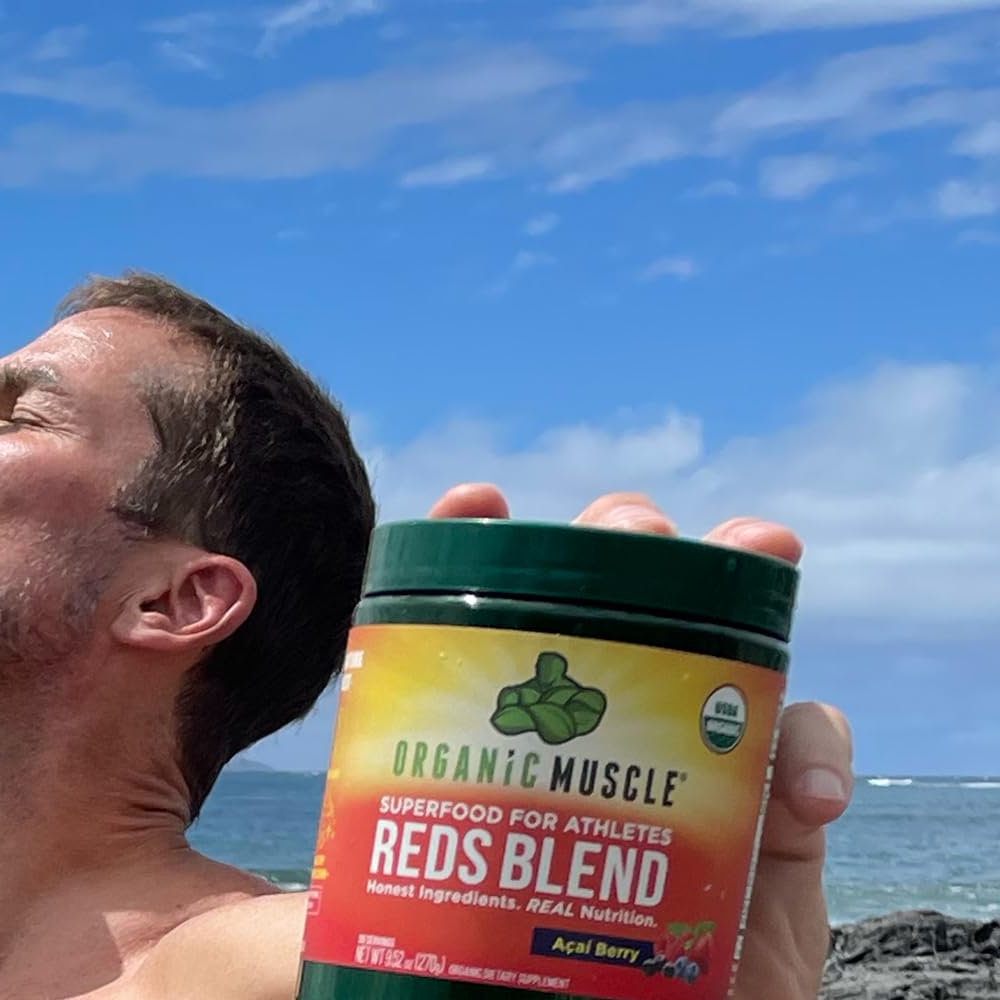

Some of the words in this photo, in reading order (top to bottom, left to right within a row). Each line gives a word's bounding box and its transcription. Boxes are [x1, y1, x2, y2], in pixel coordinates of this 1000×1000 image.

[379, 796, 503, 825] SUPERFOOD
[509, 809, 558, 830] FOR
[563, 816, 674, 846] ATHLETES
[369, 819, 493, 885] REDS
[499, 832, 669, 907] BLEND
[366, 879, 415, 898] Honest
[418, 885, 521, 911] Ingredients.
[526, 898, 575, 918] REAL
[580, 905, 658, 929] Nutrition.
[595, 942, 641, 963] Berry
